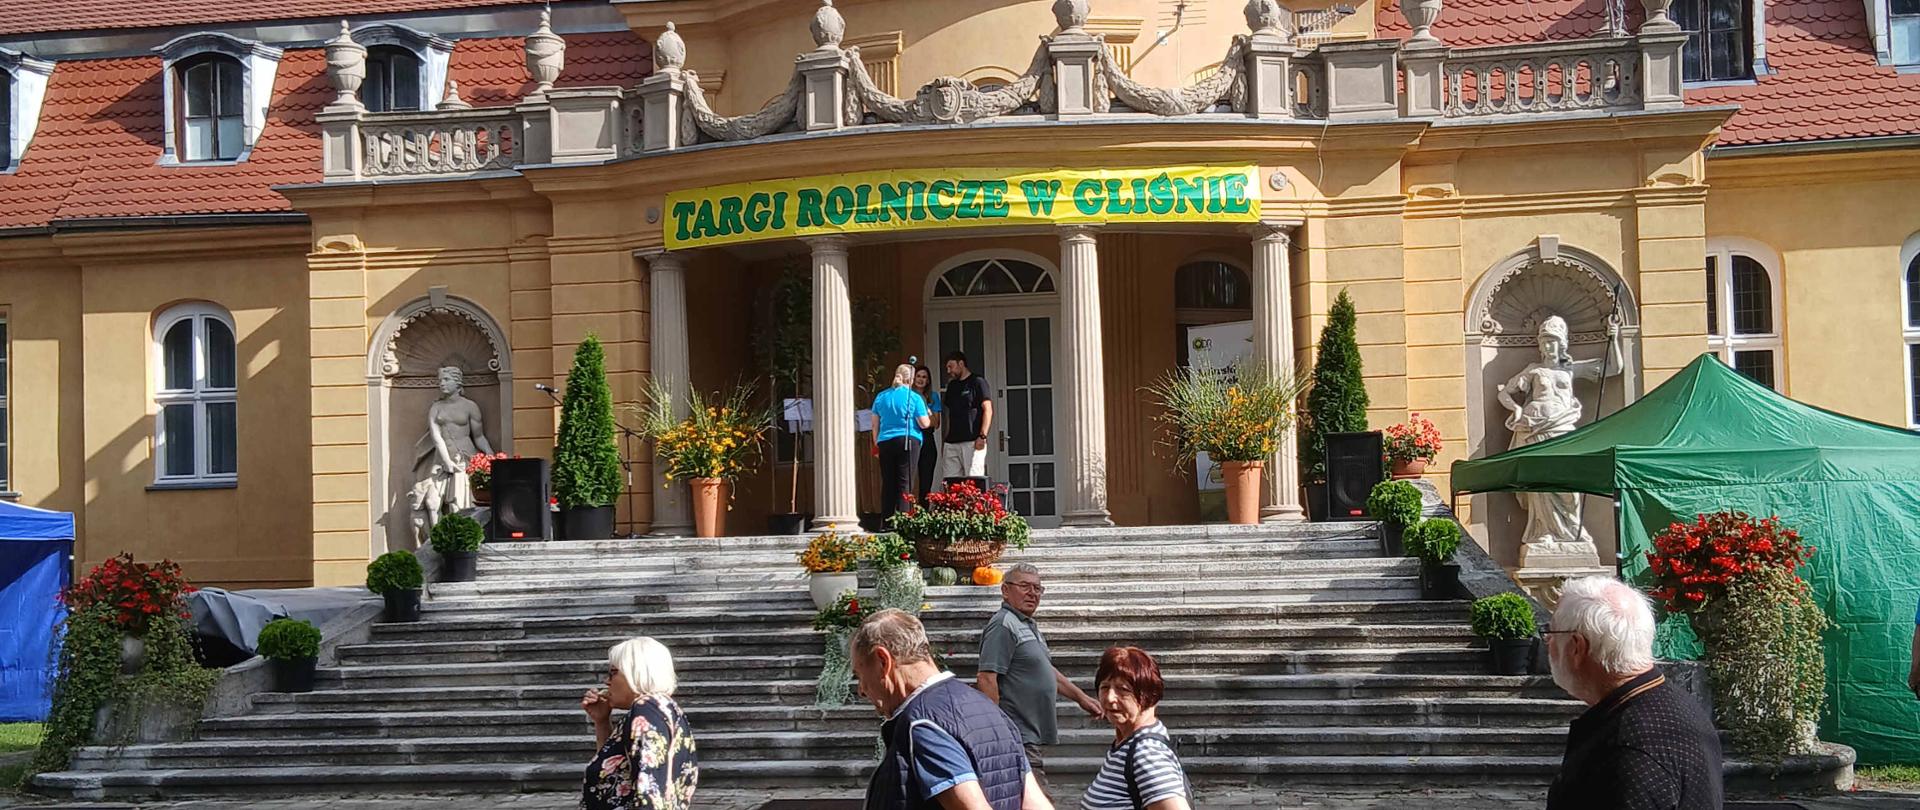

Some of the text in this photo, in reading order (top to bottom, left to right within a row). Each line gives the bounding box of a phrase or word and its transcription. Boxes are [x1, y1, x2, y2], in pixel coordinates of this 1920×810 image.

[672, 171, 1252, 241] TARGI ROLNICZE W GLIŚNIE
